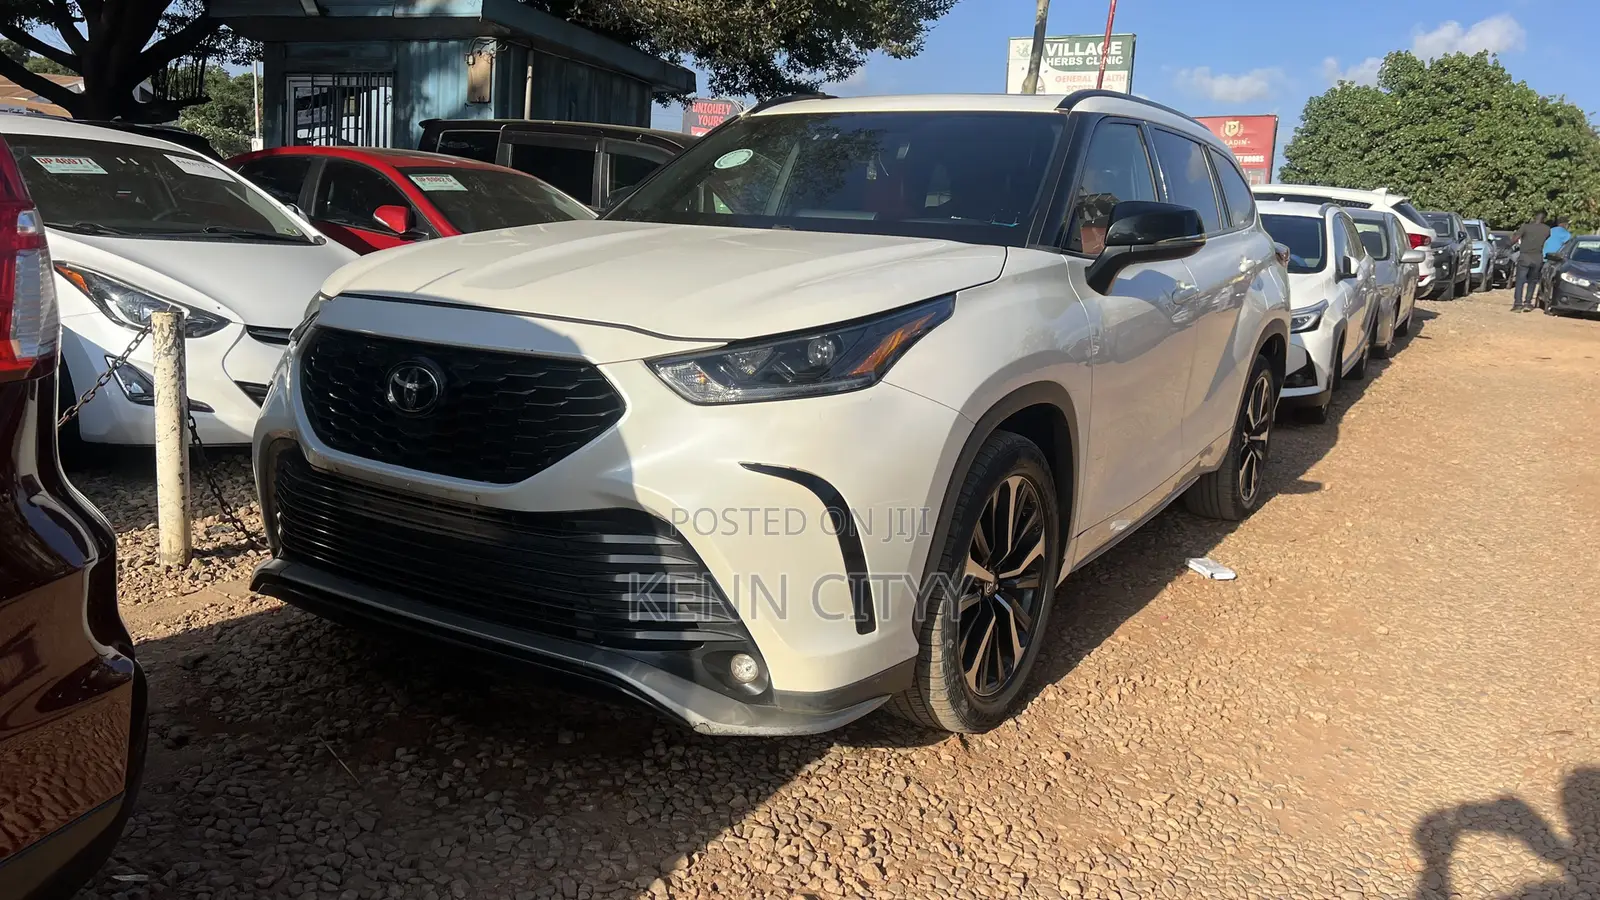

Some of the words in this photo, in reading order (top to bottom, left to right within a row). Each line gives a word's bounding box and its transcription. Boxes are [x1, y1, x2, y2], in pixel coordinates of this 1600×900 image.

[1045, 41, 1122, 56] VILLAGE
[1047, 57, 1083, 66] HERBS
[1085, 56, 1124, 66] CLNIC
[1055, 75, 1092, 83] GENERAL
[693, 102, 731, 115] UNIQUELY
[698, 115, 724, 127] YOURS
